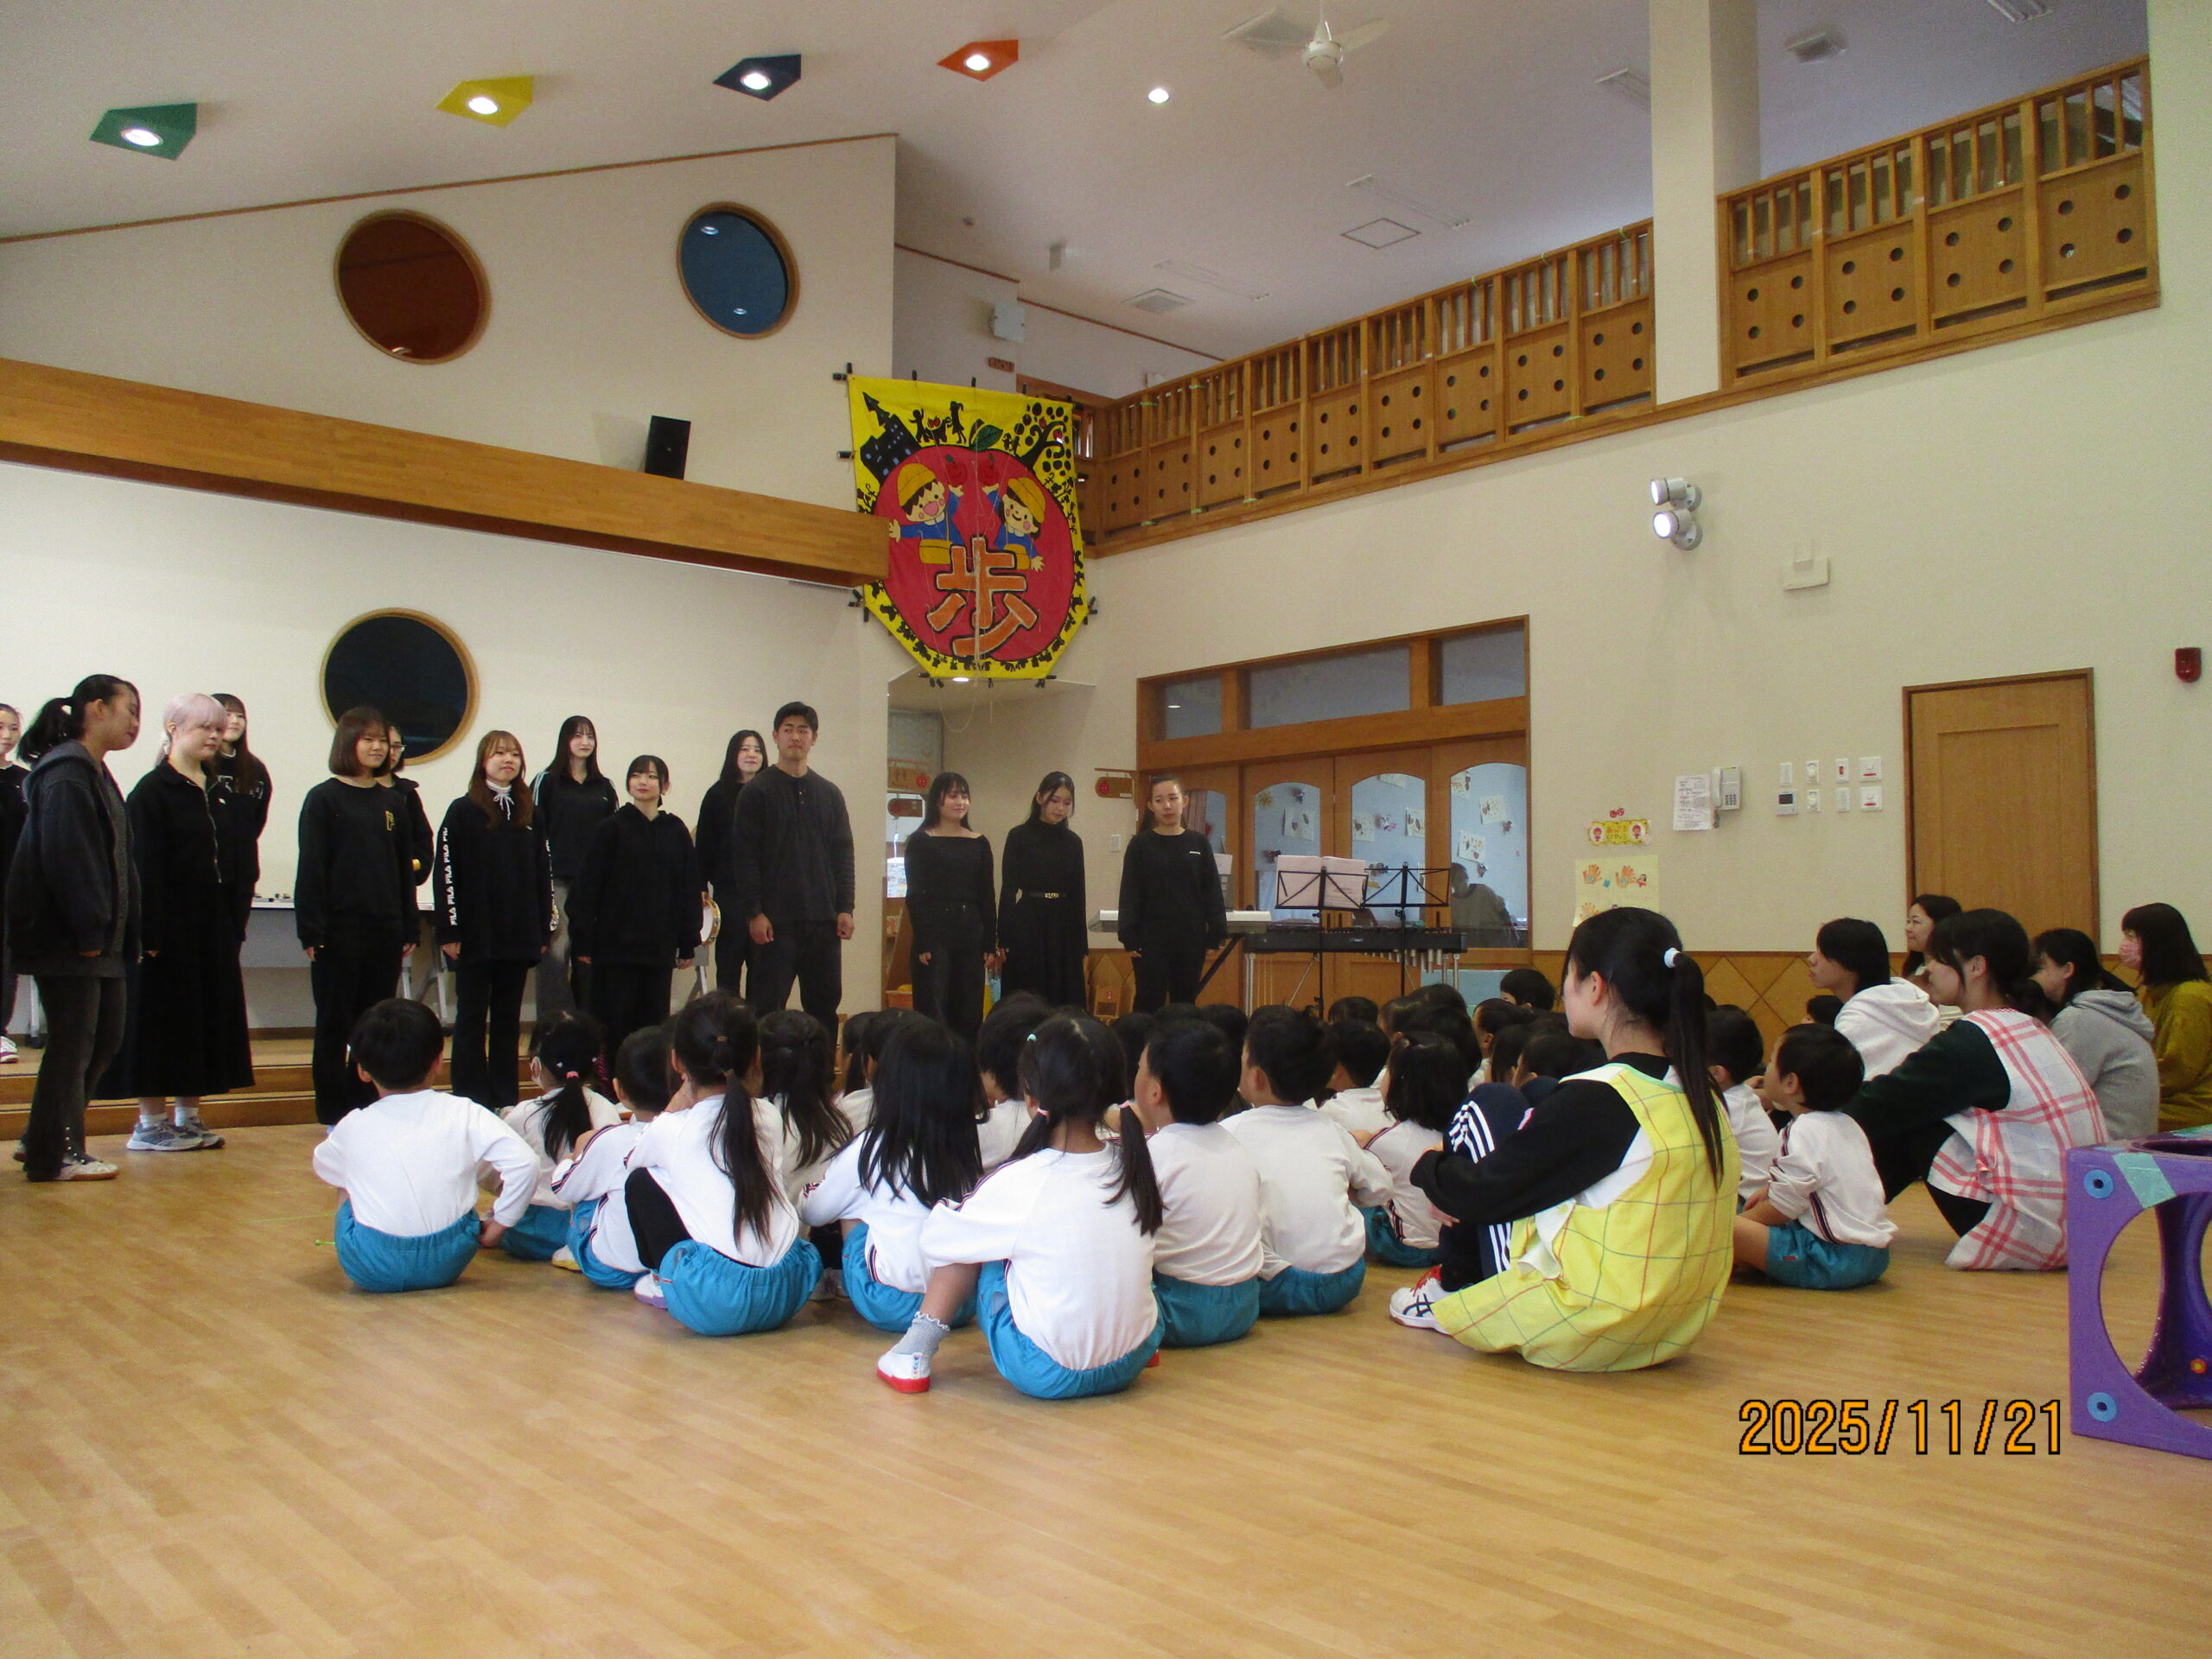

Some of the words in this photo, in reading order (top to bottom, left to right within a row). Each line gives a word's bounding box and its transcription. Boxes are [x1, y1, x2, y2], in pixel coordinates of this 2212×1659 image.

[926, 532, 1041, 659] 歩
[444, 865, 453, 884] FILA
[446, 886, 455, 905] FILA
[448, 906, 458, 925] FILA
